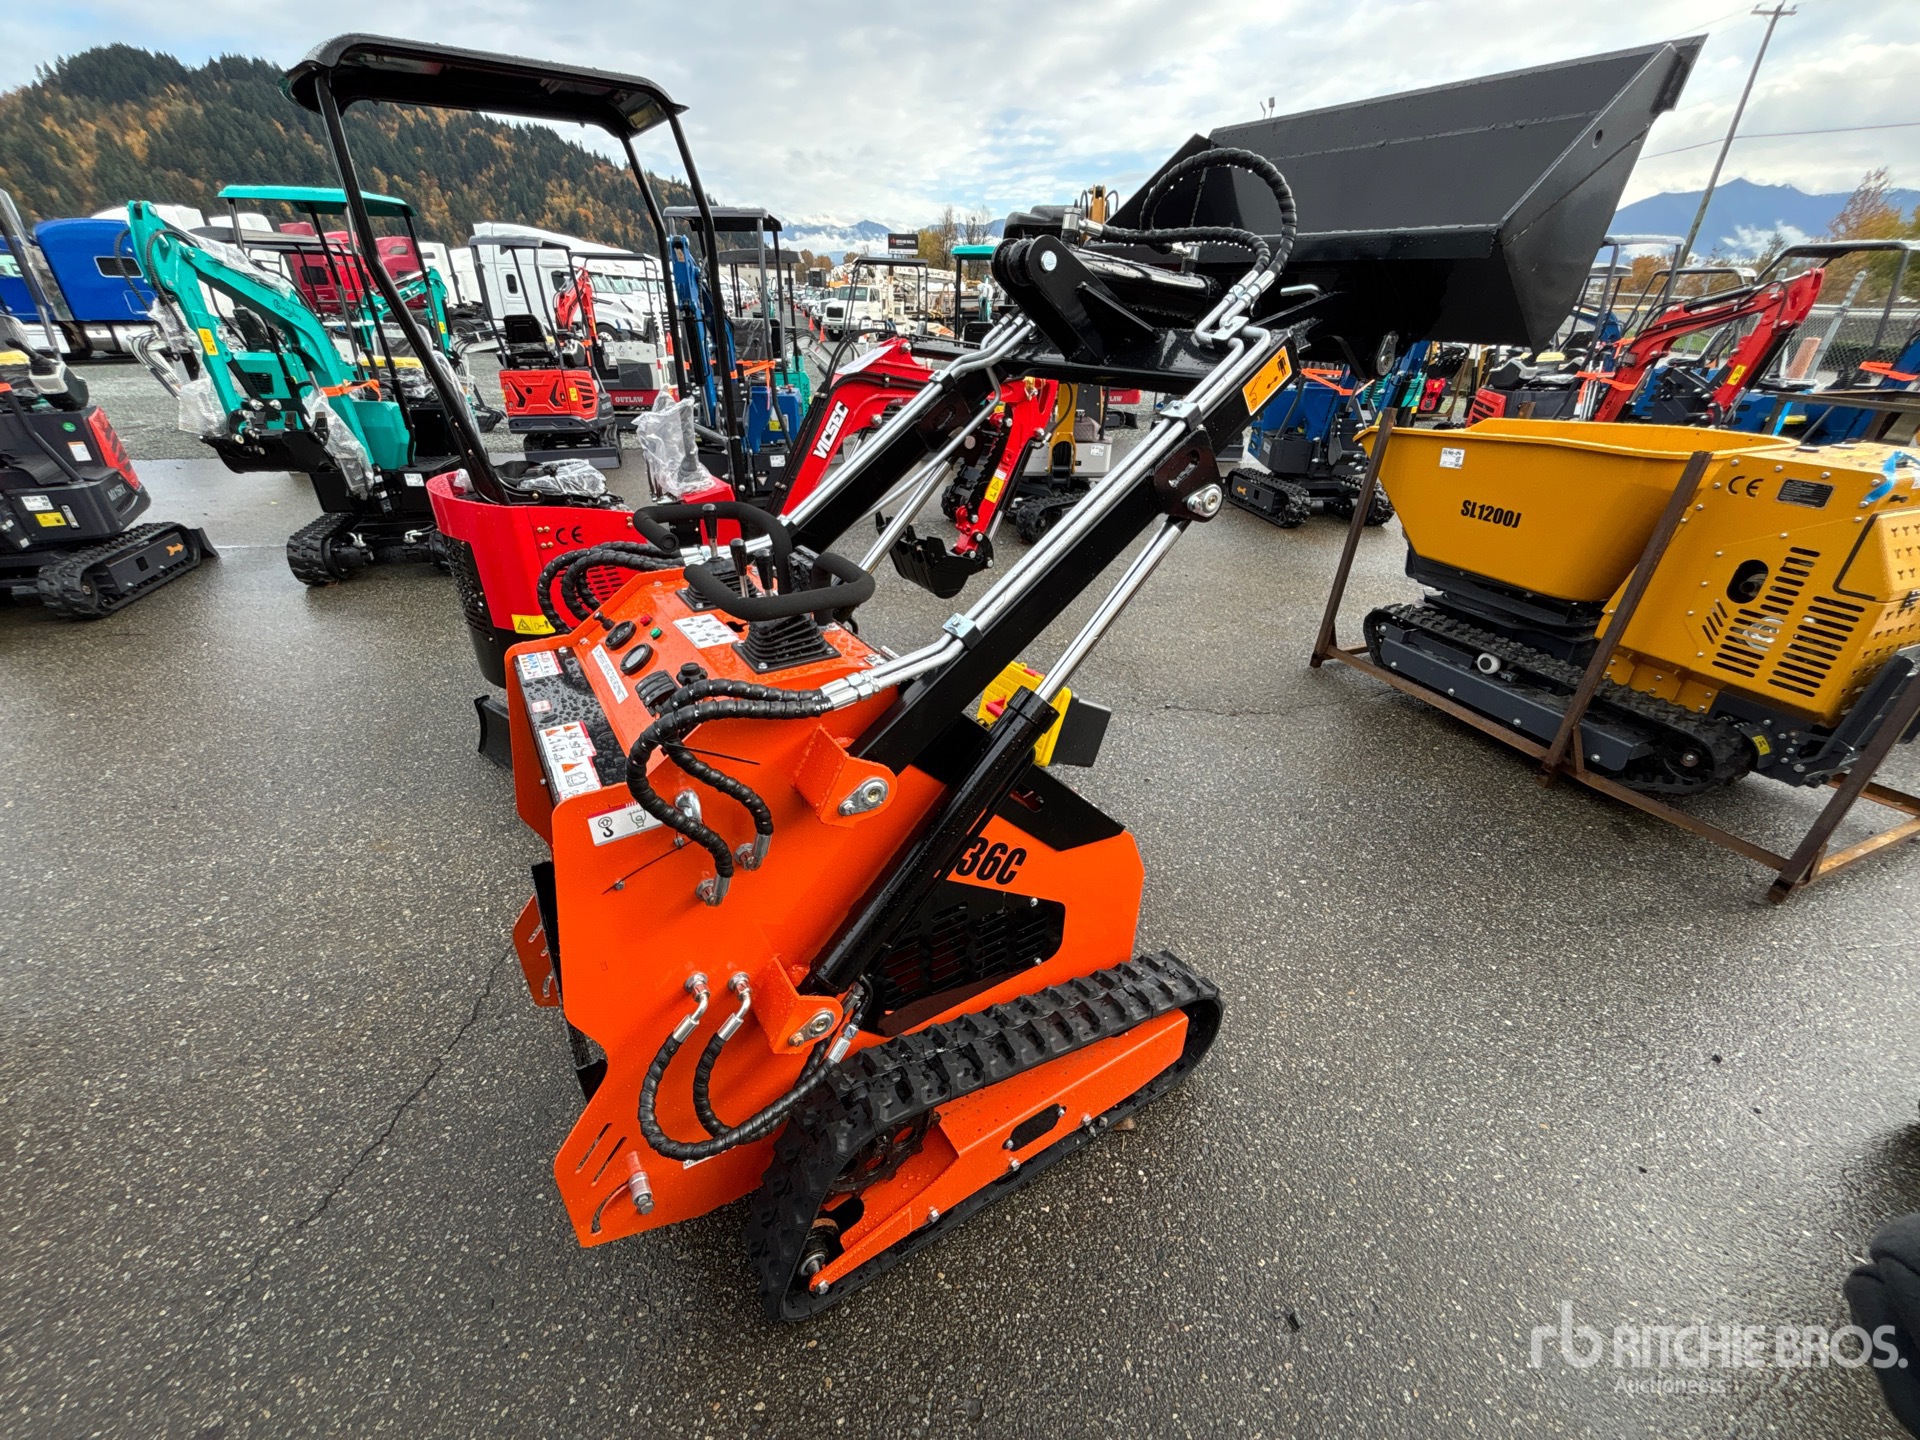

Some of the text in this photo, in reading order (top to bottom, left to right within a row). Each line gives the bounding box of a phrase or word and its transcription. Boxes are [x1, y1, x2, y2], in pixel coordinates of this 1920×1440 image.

[812, 400, 850, 459] VICSEC
[1727, 475, 1764, 497] CE
[1460, 499, 1522, 529] SL1200J
[555, 525, 585, 546] CE
[955, 836, 1028, 885] 36C
